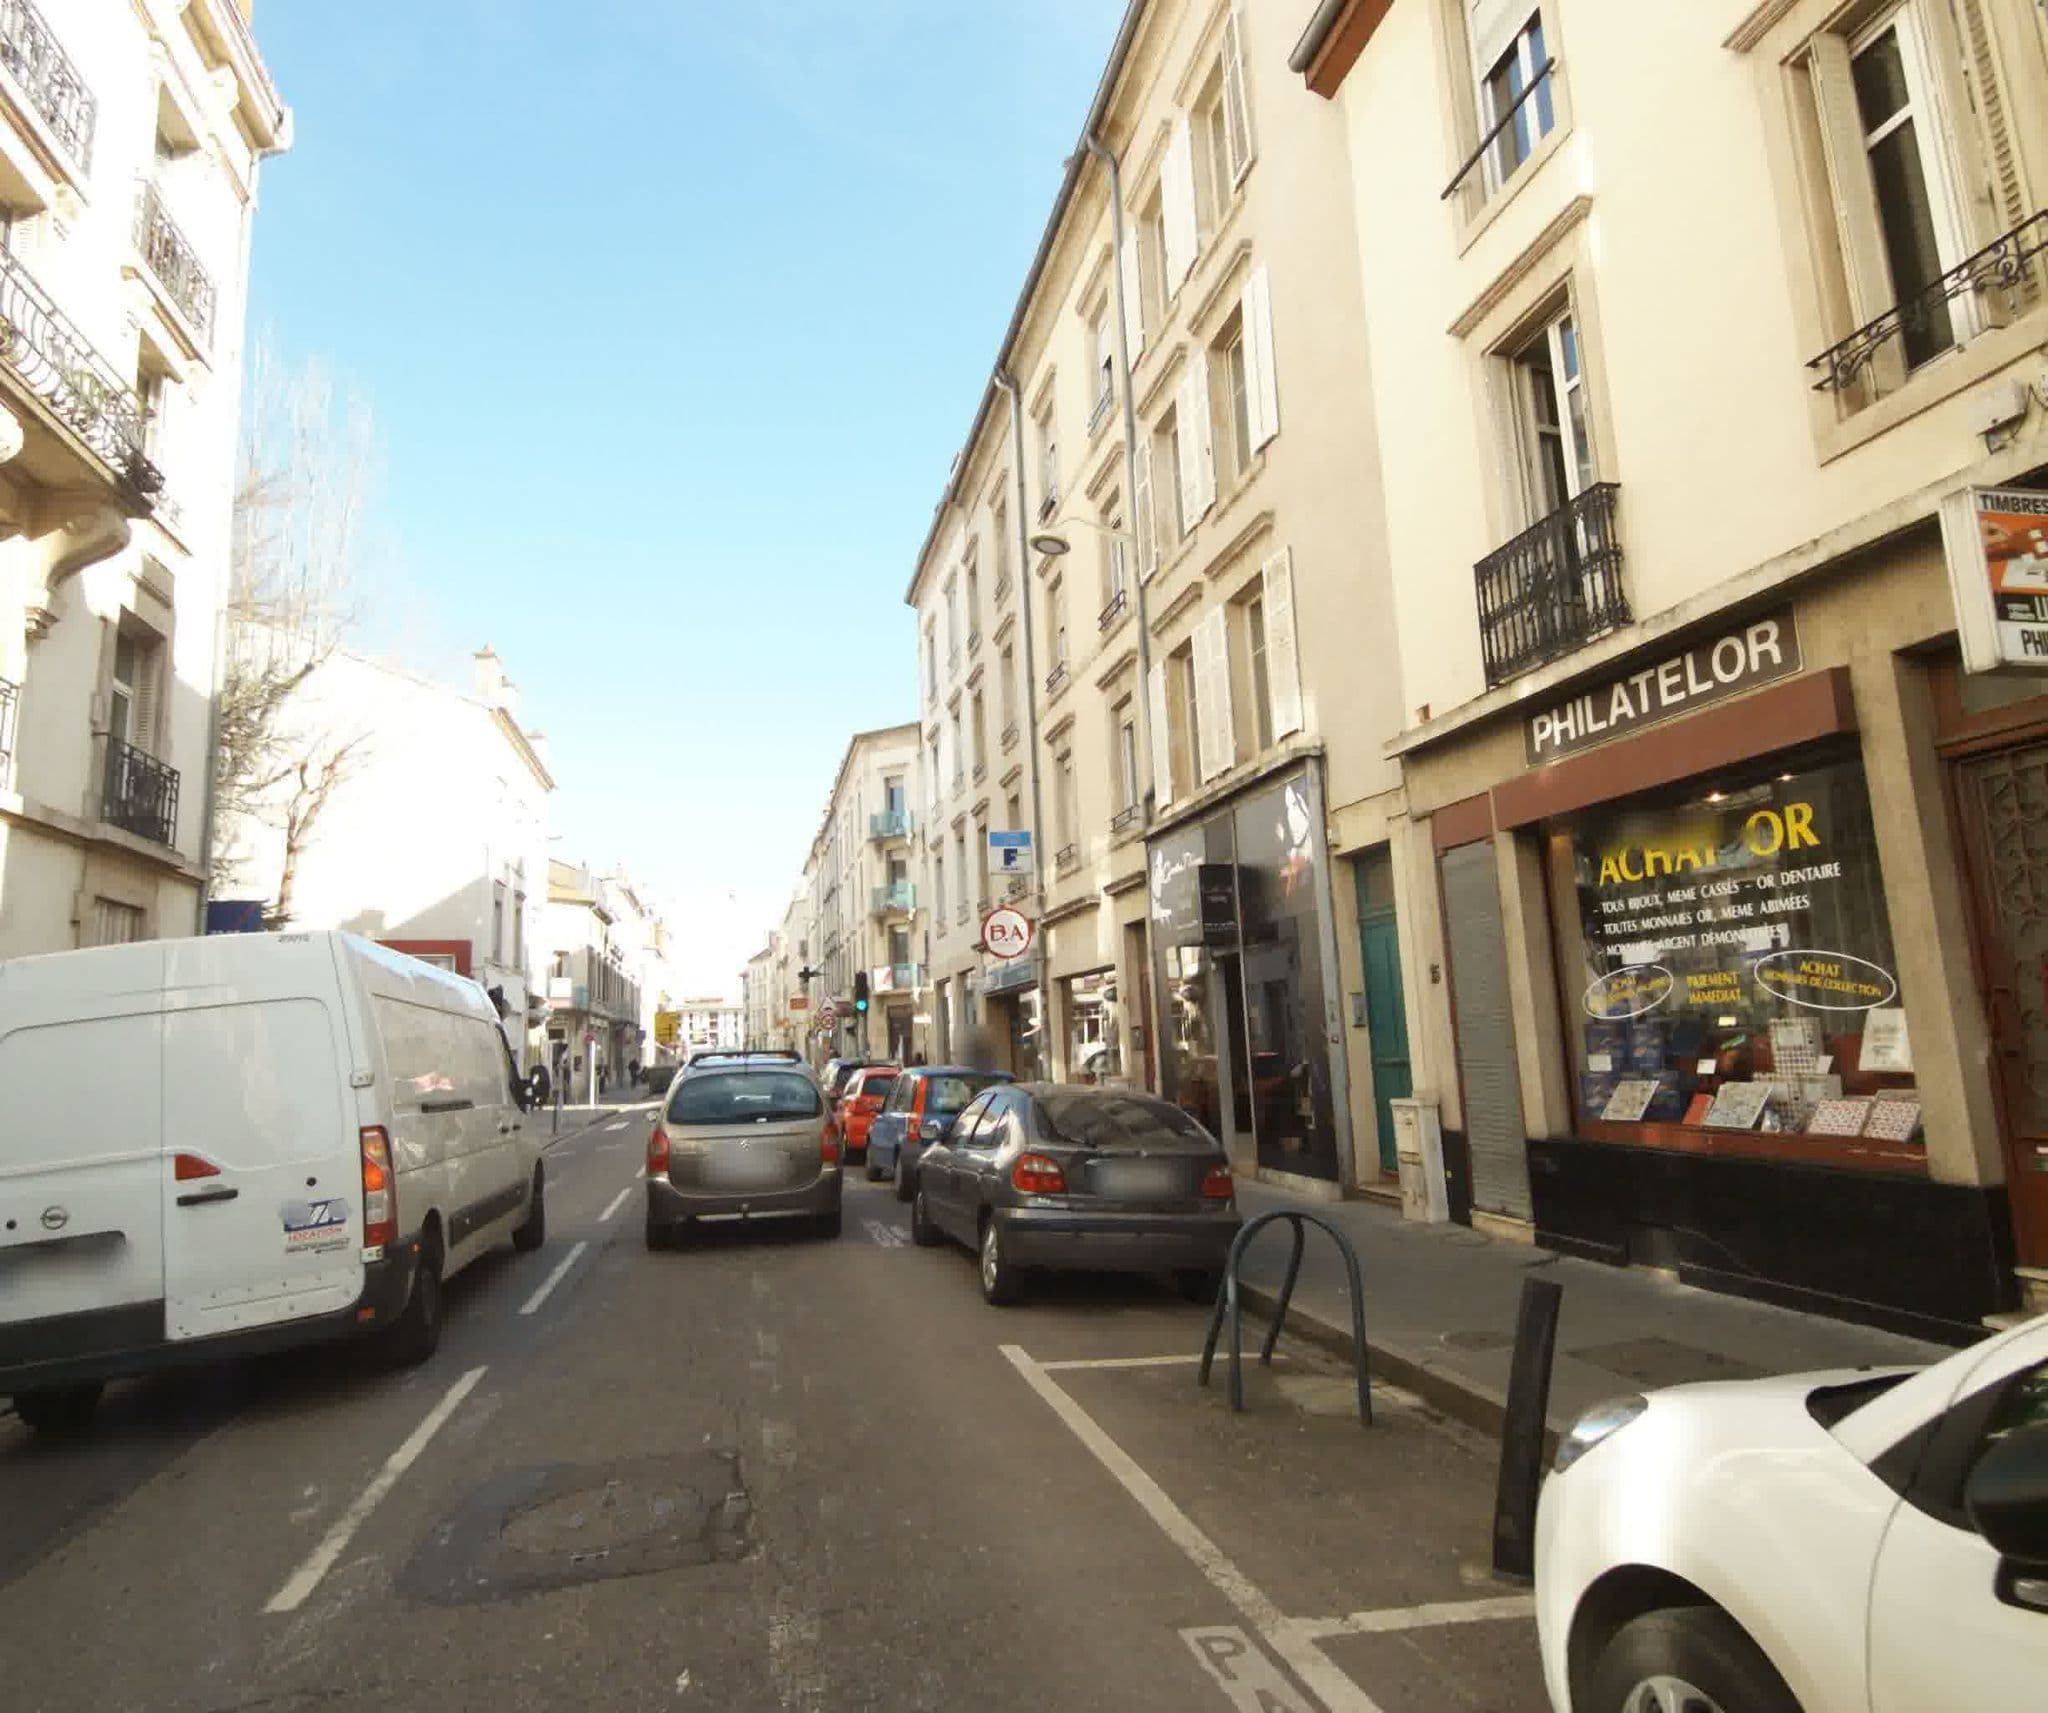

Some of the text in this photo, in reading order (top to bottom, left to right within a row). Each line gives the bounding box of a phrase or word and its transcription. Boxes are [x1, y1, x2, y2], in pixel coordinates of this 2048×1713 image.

[1979, 494, 2048, 514] TIMBRES
[1532, 620, 1782, 752] PHILATELOR
[1744, 802, 1821, 857] OR
[1602, 899, 1625, 914] TOUS
[1700, 878, 1739, 899] CASSÉS
[1757, 874, 1775, 890] OR
[1780, 862, 1841, 886] DENTAIRE
[1604, 921, 1638, 935] TOUTES
[1641, 912, 1693, 930] MONNAIES
[1799, 961, 1841, 978] ACHAT
